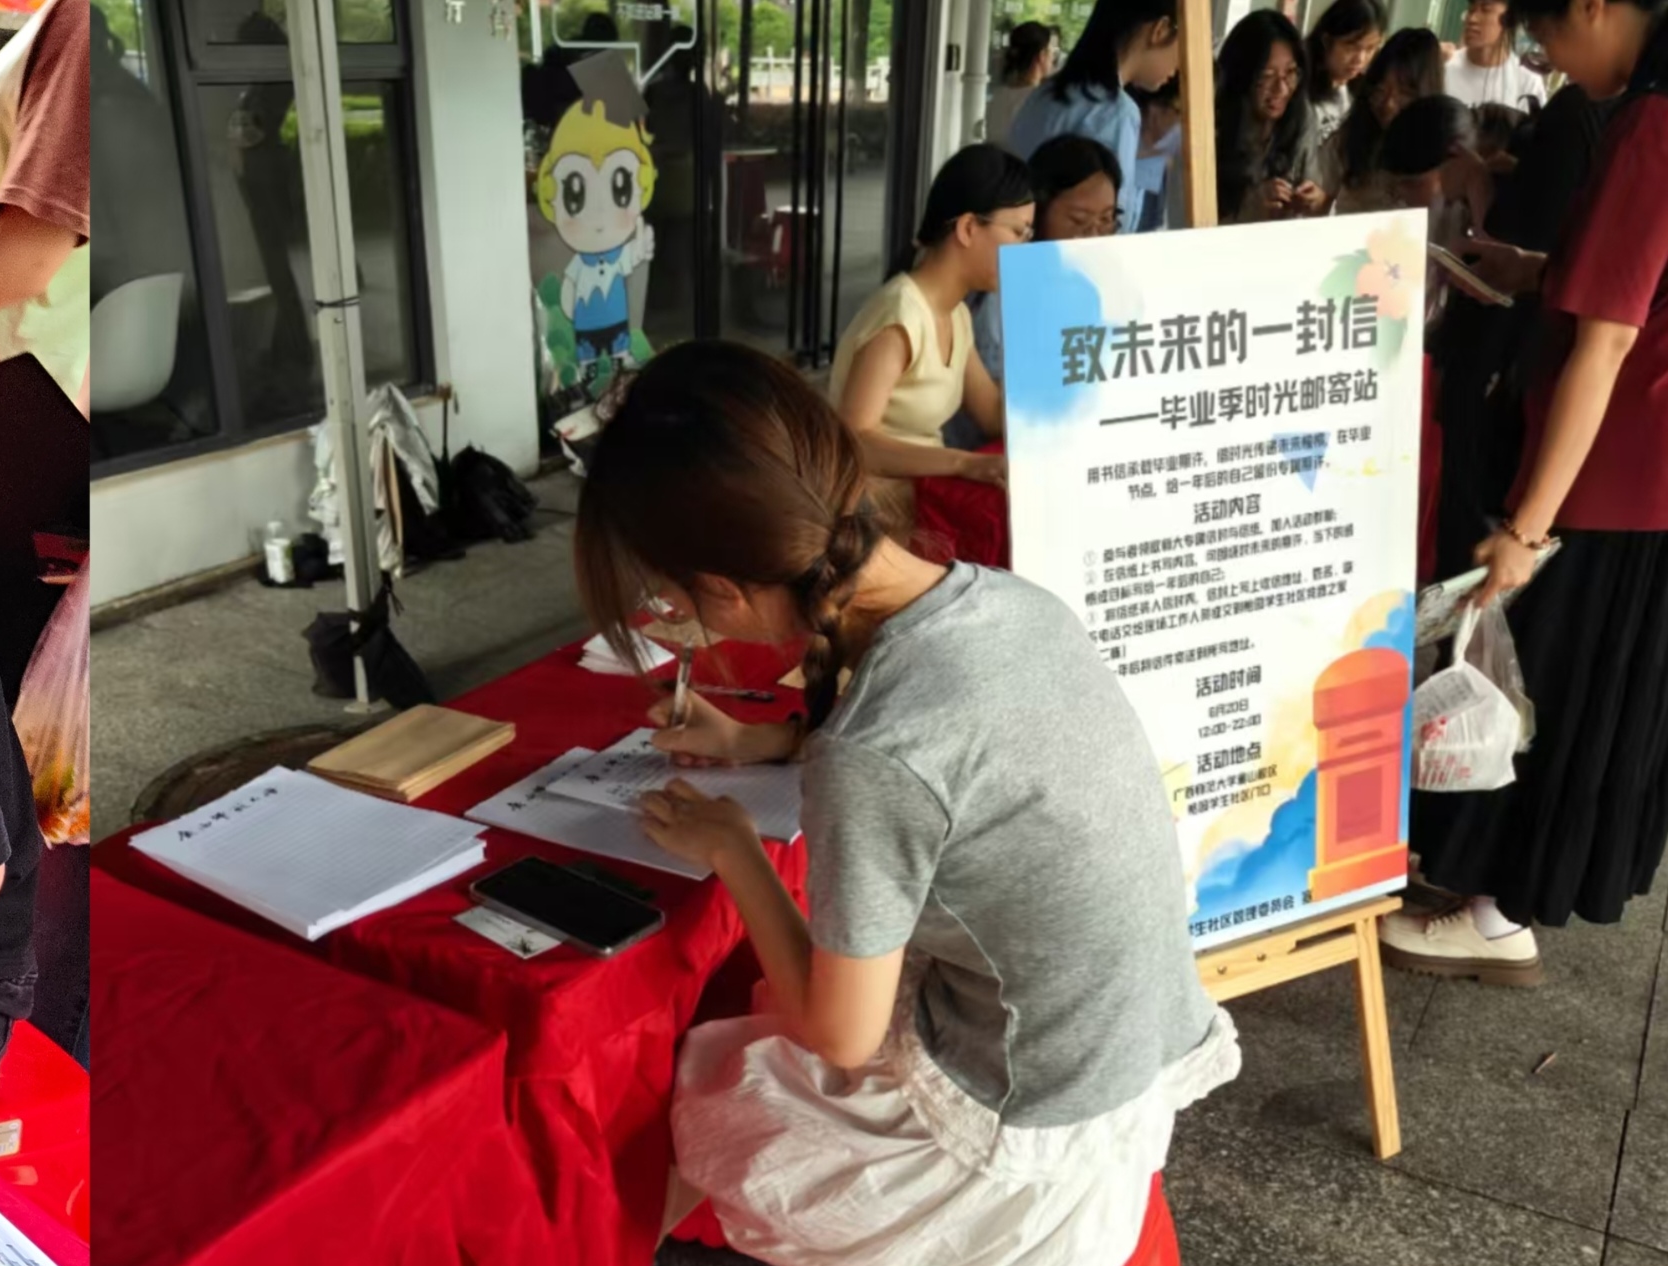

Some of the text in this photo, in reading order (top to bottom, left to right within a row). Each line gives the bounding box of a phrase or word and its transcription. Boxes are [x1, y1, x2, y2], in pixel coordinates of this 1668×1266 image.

[1060, 294, 1379, 385] 致未来的一封信
[1193, 493, 1261, 524] 活动内容
[1196, 665, 1262, 698] 活动时间
[1197, 741, 1262, 774] 活动地点
